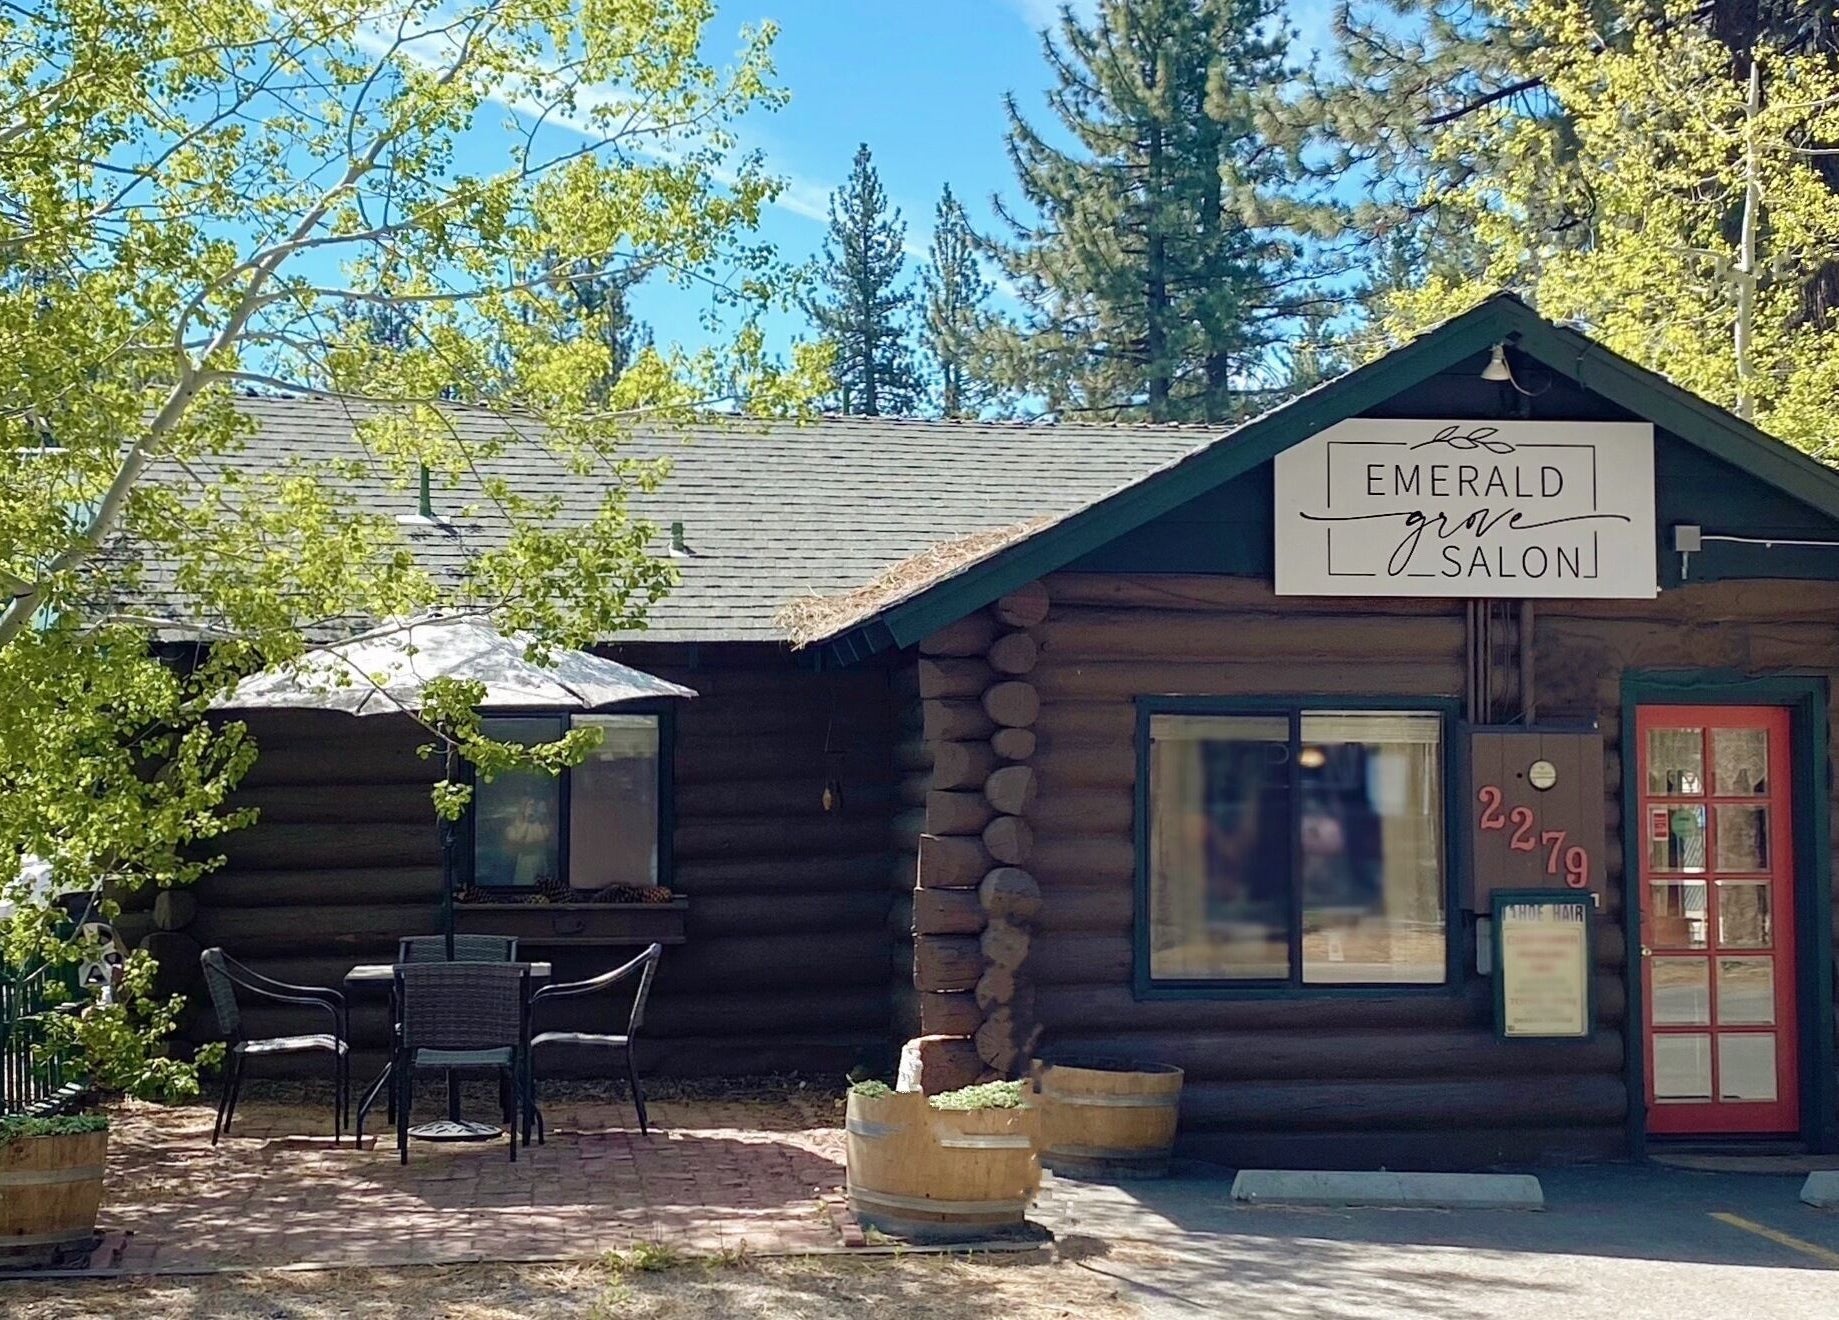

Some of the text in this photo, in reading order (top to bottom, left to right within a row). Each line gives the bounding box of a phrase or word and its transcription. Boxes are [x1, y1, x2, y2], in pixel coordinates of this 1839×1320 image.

[1367, 464, 1564, 498] EMERALD
[1300, 507, 1631, 576] grove
[1441, 545, 1579, 578] SALON
[1479, 785, 1588, 889] 2279
[1553, 904, 1583, 922] HAIR
